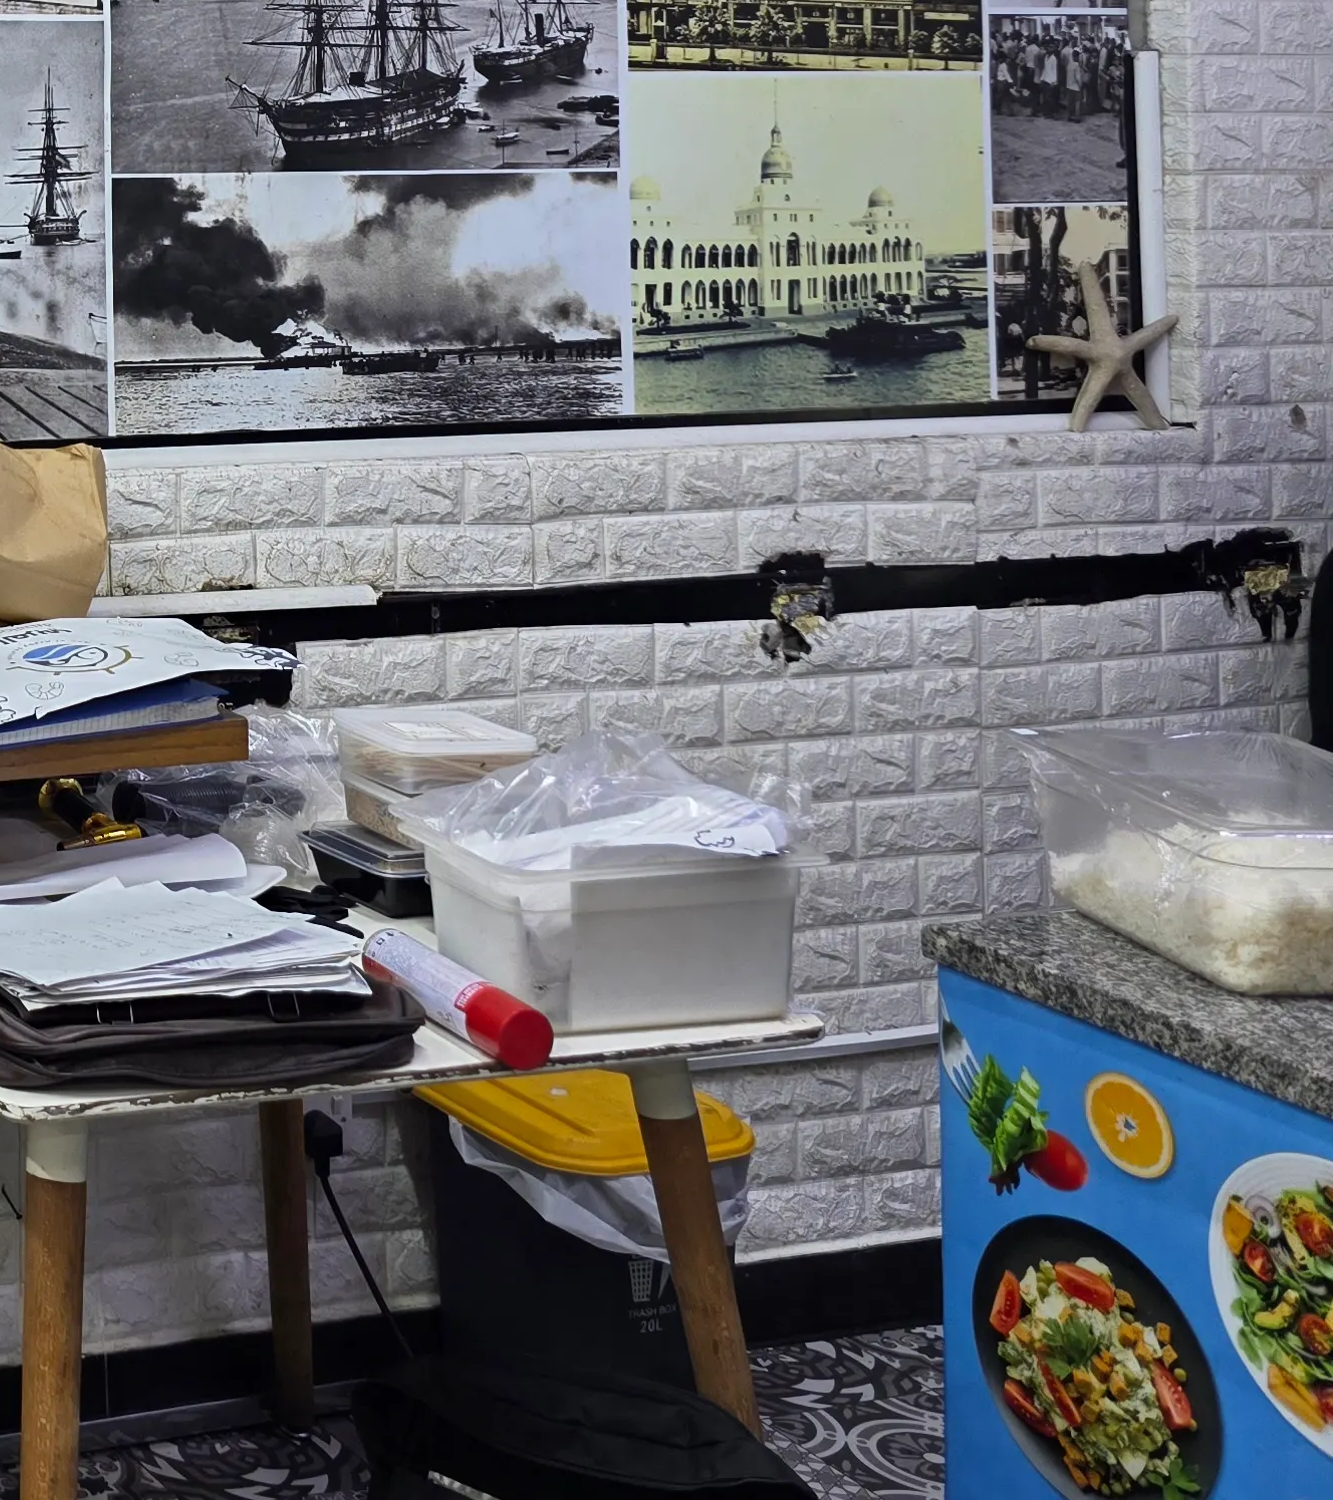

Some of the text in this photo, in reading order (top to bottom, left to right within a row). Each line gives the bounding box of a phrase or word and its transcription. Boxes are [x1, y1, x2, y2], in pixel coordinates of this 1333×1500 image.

[628, 1303, 677, 1320] TRASH BOX
[639, 1318, 663, 1333] 20L
